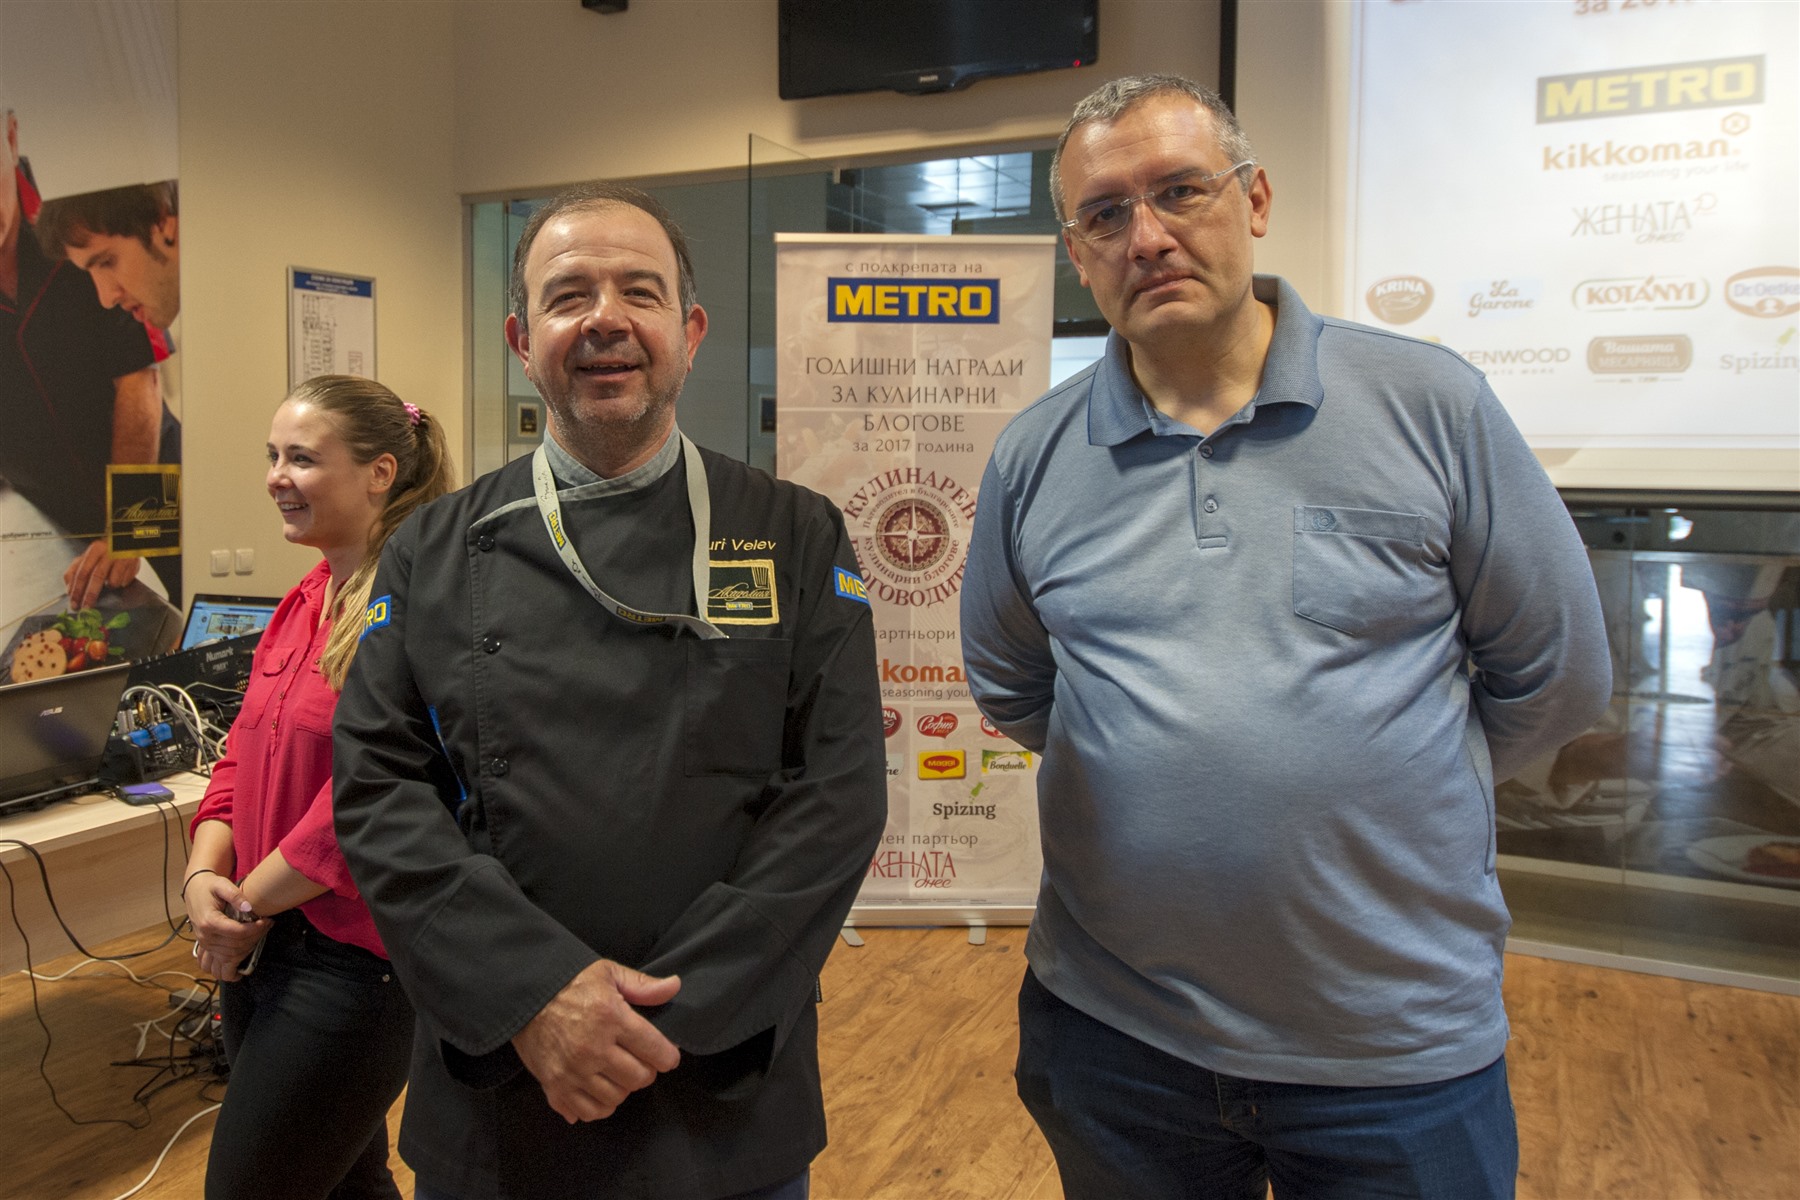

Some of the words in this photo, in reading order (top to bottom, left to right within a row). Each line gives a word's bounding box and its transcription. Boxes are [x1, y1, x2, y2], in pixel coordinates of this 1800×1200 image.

[1545, 62, 1756, 117] METRO
[1543, 139, 1730, 171] kikkoman
[1603, 166, 1681, 182] seasoning
[1685, 160, 1720, 178] your
[846, 263, 854, 272] с
[860, 261, 957, 276] подкрепата
[964, 263, 983, 273] на
[1376, 279, 1426, 297] KRINA
[835, 284, 992, 317] METRO
[806, 357, 916, 376] ГОДИШНИ
[926, 358, 1024, 377] НАГРАДИ
[1719, 352, 1799, 374] Spizin
[832, 385, 858, 404] ЗА
[867, 386, 996, 404] КУЛИНАРНИ
[864, 414, 965, 432] БЛОГОВЕ
[852, 441, 869, 452] за
[875, 439, 910, 452] 2017
[917, 441, 974, 453] година
[844, 467, 977, 520] КУЛИНАРЕН
[731, 539, 776, 550] Velev
[865, 537, 921, 584] кулинарни
[924, 540, 959, 581] блогове
[877, 658, 968, 684] koma
[882, 688, 943, 699] seasoning
[990, 761, 1027, 772] Bonduelle
[933, 801, 996, 819] Spizing
[913, 834, 978, 848] партьор
